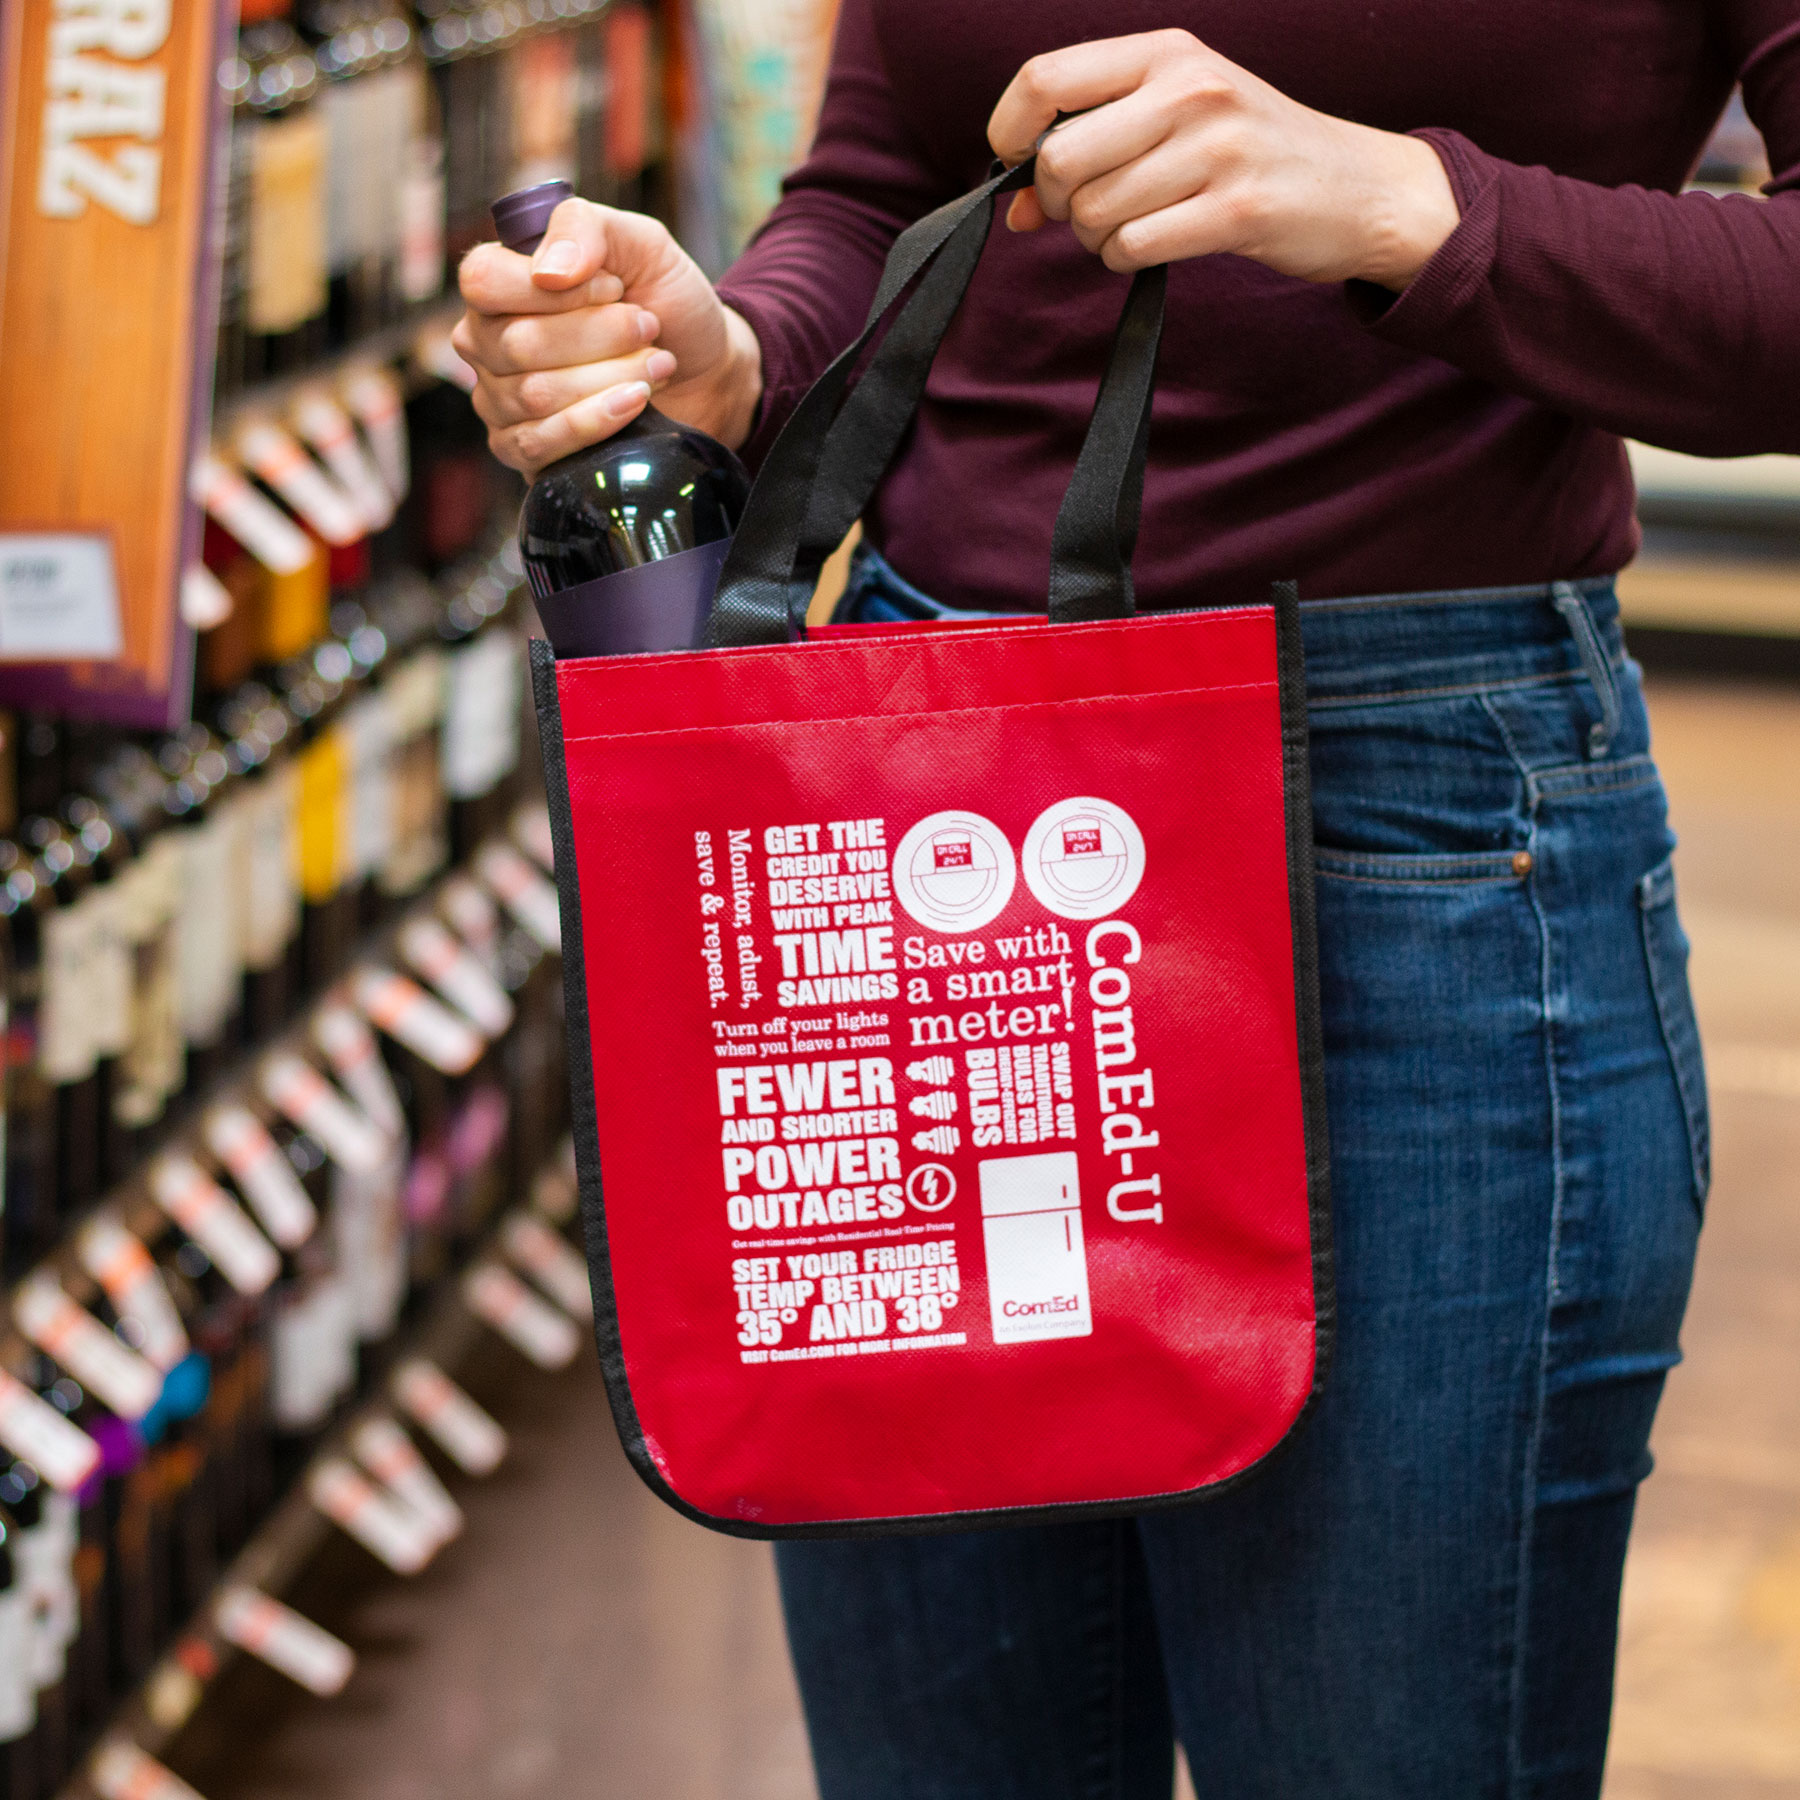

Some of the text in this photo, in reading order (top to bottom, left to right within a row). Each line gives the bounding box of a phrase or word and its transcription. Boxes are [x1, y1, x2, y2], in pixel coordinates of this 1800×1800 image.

[764, 818, 886, 854] GET THE
[937, 845, 968, 855] ON CALL
[1073, 842, 1093, 852] 24/7
[1078, 832, 1097, 841] CALL
[767, 849, 887, 878] CREDIT YOU
[944, 856, 964, 865] 24/7
[768, 872, 891, 906] DESERVE
[695, 830, 729, 1008] save & repeat.
[728, 828, 762, 1009] Monitor, adust,
[771, 901, 893, 930] WITH PEAK
[773, 926, 896, 978] TIME
[903, 923, 1071, 969] Save with
[777, 973, 899, 1007] SAVINGS
[907, 956, 1075, 1004] a smart
[712, 1012, 889, 1037] Turn off your lights
[909, 987, 1075, 1046] meter!
[714, 1033, 890, 1058] when you leave a room
[716, 1057, 897, 1116] FEWER
[998, 1046, 1017, 1144] ENERGY-EFFICIENT
[1013, 1045, 1037, 1143] BULBS FOR
[1033, 1043, 1054, 1141] TRADITIONAL
[1051, 1042, 1076, 1139] SWAP OUT
[1085, 920, 1164, 1224] ComEd-U
[965, 1048, 1003, 1147] BULBS
[721, 1109, 898, 1144] AND SHORTER
[722, 1137, 902, 1192] POWER
[726, 1184, 905, 1231] OUTAGES
[732, 1240, 747, 1248] Get
[786, 1237, 816, 1246] savings
[818, 1233, 836, 1243] with
[926, 1223, 955, 1232] Pricing
[732, 1241, 957, 1282] SET YOUR FRIDGE
[733, 1264, 960, 1311] TEMP BETWEEN
[1003, 1294, 1079, 1318] ComEd
[736, 1292, 958, 1346] 35° AND 38°
[740, 1350, 768, 1364] VISIT
[836, 1342, 858, 1356] FOR
[859, 1339, 890, 1354] MORE
[892, 1332, 967, 1350] INFORMATION
